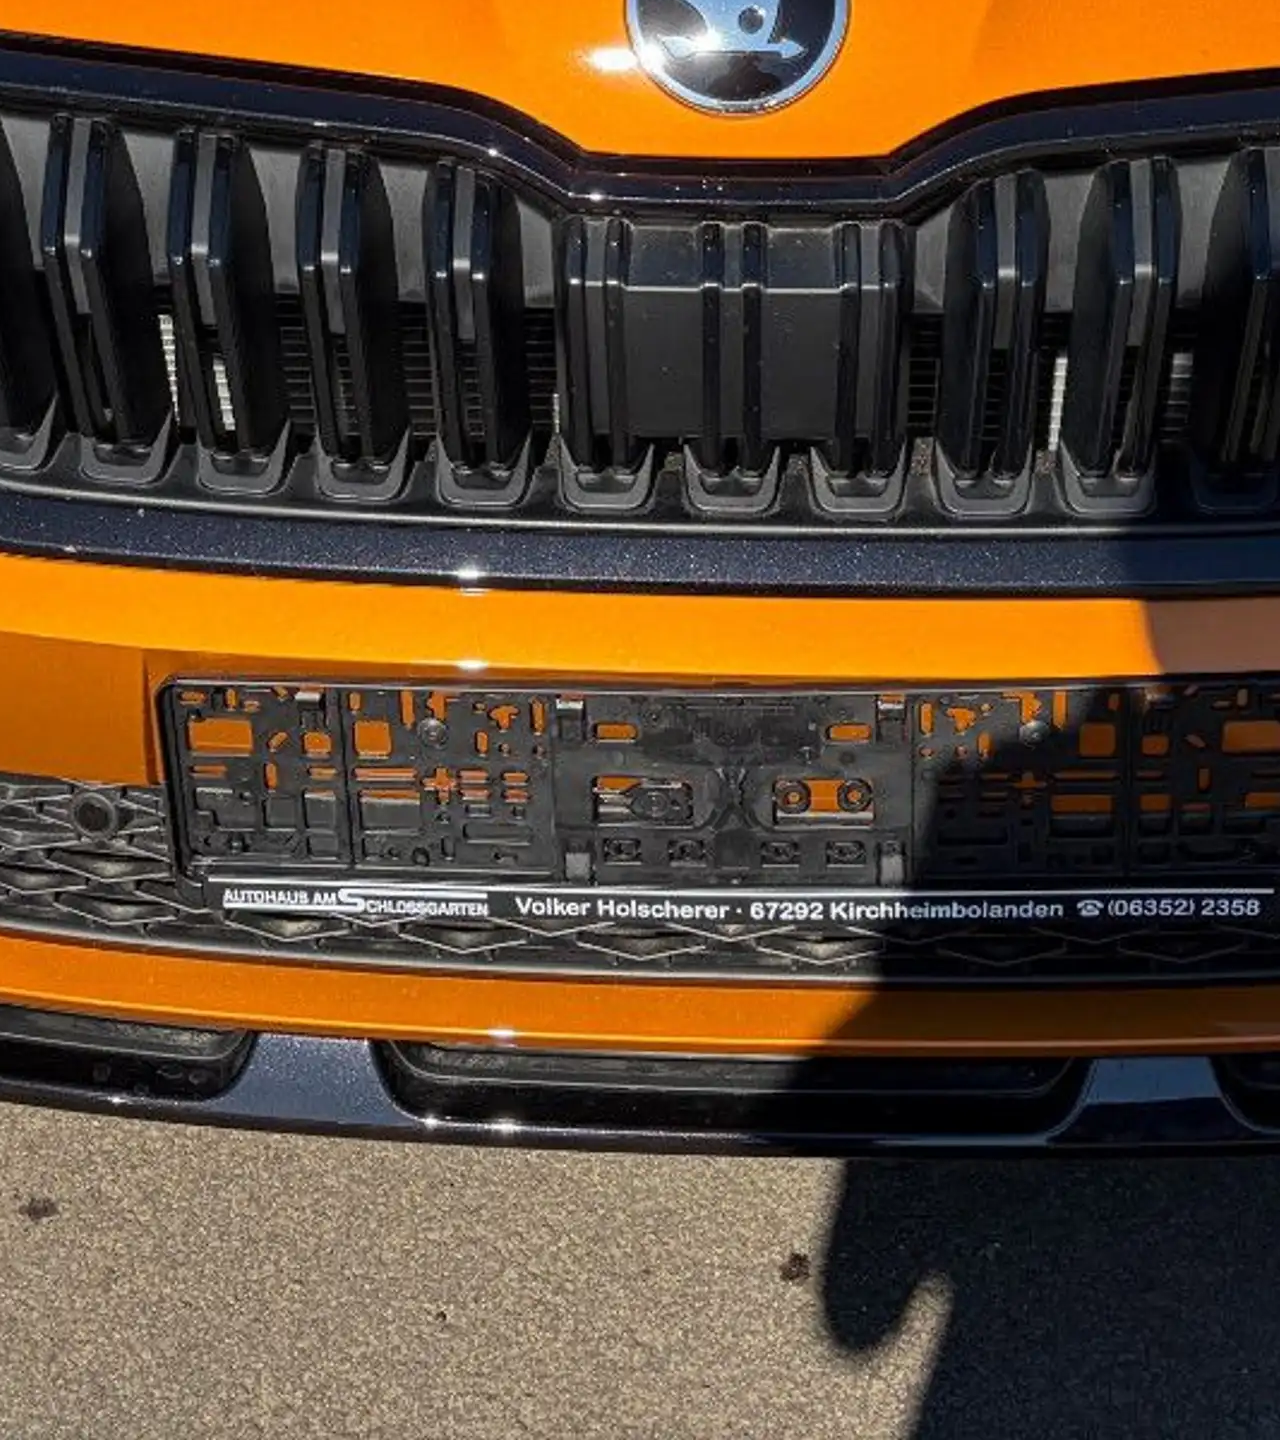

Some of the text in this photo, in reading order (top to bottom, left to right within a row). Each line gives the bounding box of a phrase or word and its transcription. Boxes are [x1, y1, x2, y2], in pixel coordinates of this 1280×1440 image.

[223, 887, 490, 917] AUTOHAUS AM SCHLOSSGARTEN
[515, 896, 1261, 921] Volker Holscherer 67292 Kirchheimbolanden (06352) 2358
